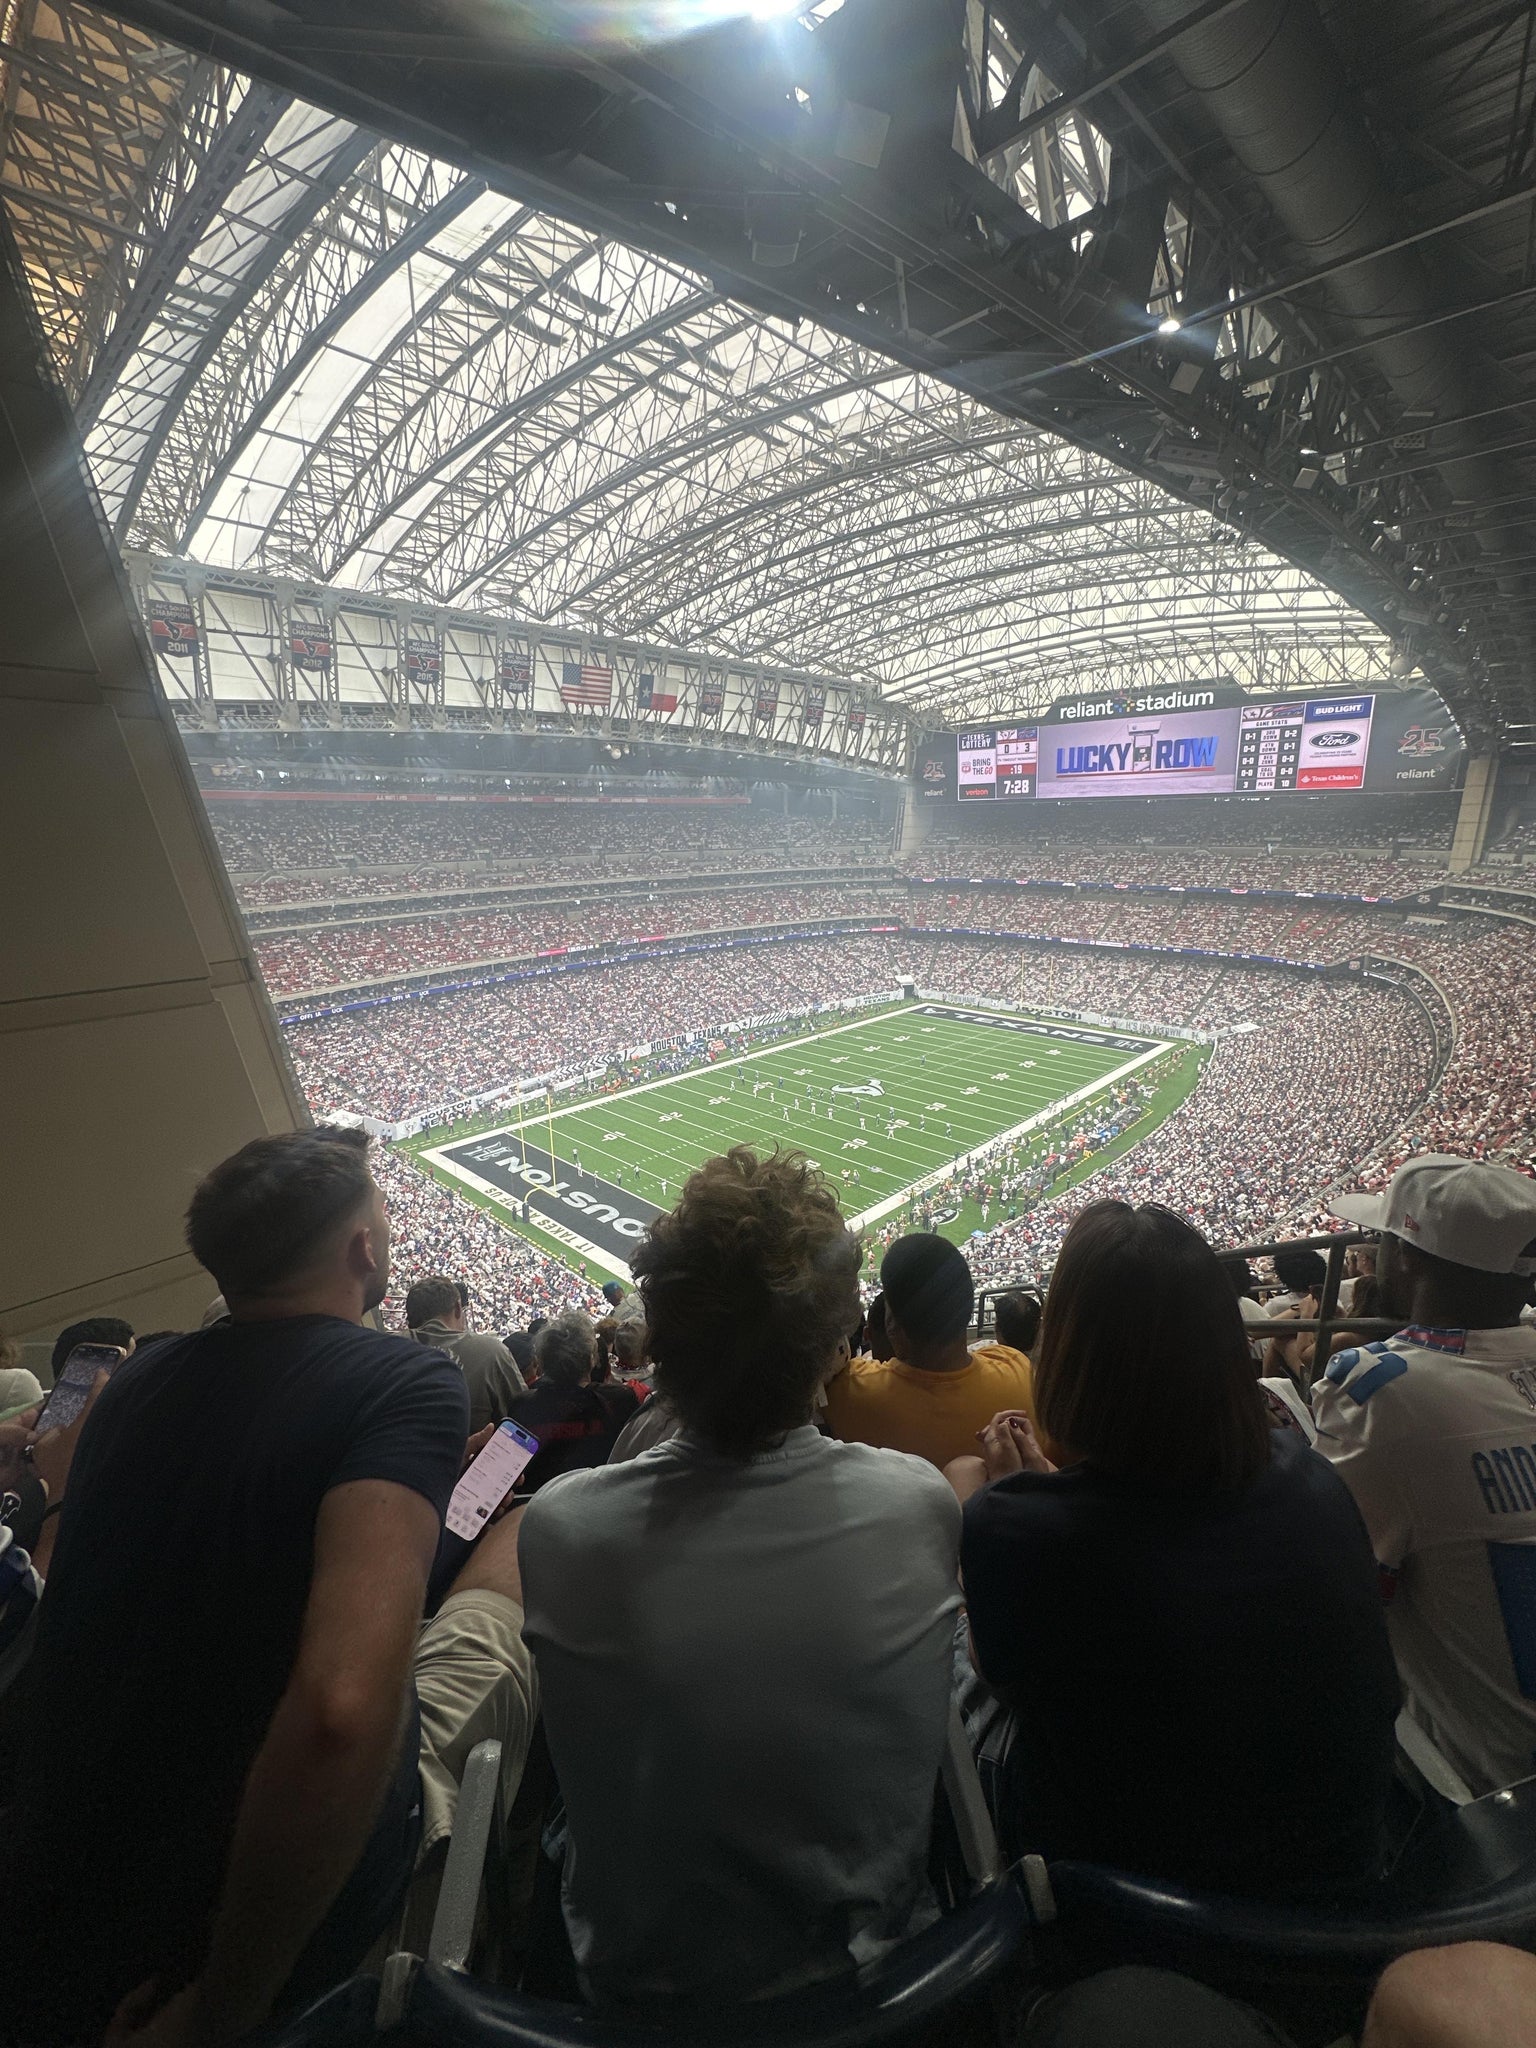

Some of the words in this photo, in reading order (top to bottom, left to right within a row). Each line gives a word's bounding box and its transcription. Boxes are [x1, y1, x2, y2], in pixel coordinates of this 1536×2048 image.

[167, 641, 189, 653] 2011
[302, 658, 323, 669] 2012
[416, 672, 434, 682] 2015
[1060, 700, 1114, 719] reliant
[1135, 691, 1214, 712] stadium
[1315, 706, 1334, 715] BUD
[1335, 704, 1362, 713] LIGHT
[1284, 729, 1297, 738] 0-2
[961, 738, 991, 749] LOTTERY
[1318, 733, 1350, 746] Ford
[1004, 744, 1010, 754] 0
[1024, 742, 1030, 753] 3
[1056, 742, 1132, 774] LUCKY
[1156, 736, 1219, 769] ROW
[972, 758, 991, 767] BRING
[973, 766, 985, 775] THE
[984, 766, 993, 775] GO
[1396, 768, 1436, 779] reliant
[965, 788, 989, 796] verizon
[1003, 779, 1029, 795] 7:28
[954, 1012, 1107, 1043] TEXANS
[650, 1034, 687, 1052] HOUSTON
[693, 1025, 721, 1040] TEXANS
[420, 1099, 472, 1122] HOUSTON
[484, 1188, 501, 1198] US
[494, 1155, 648, 1239] OUSTON
[501, 1196, 518, 1207] OF
[536, 1219, 579, 1244] TAKES
[575, 1241, 596, 1252] IT
[1472, 1444, 1536, 1514] AND
